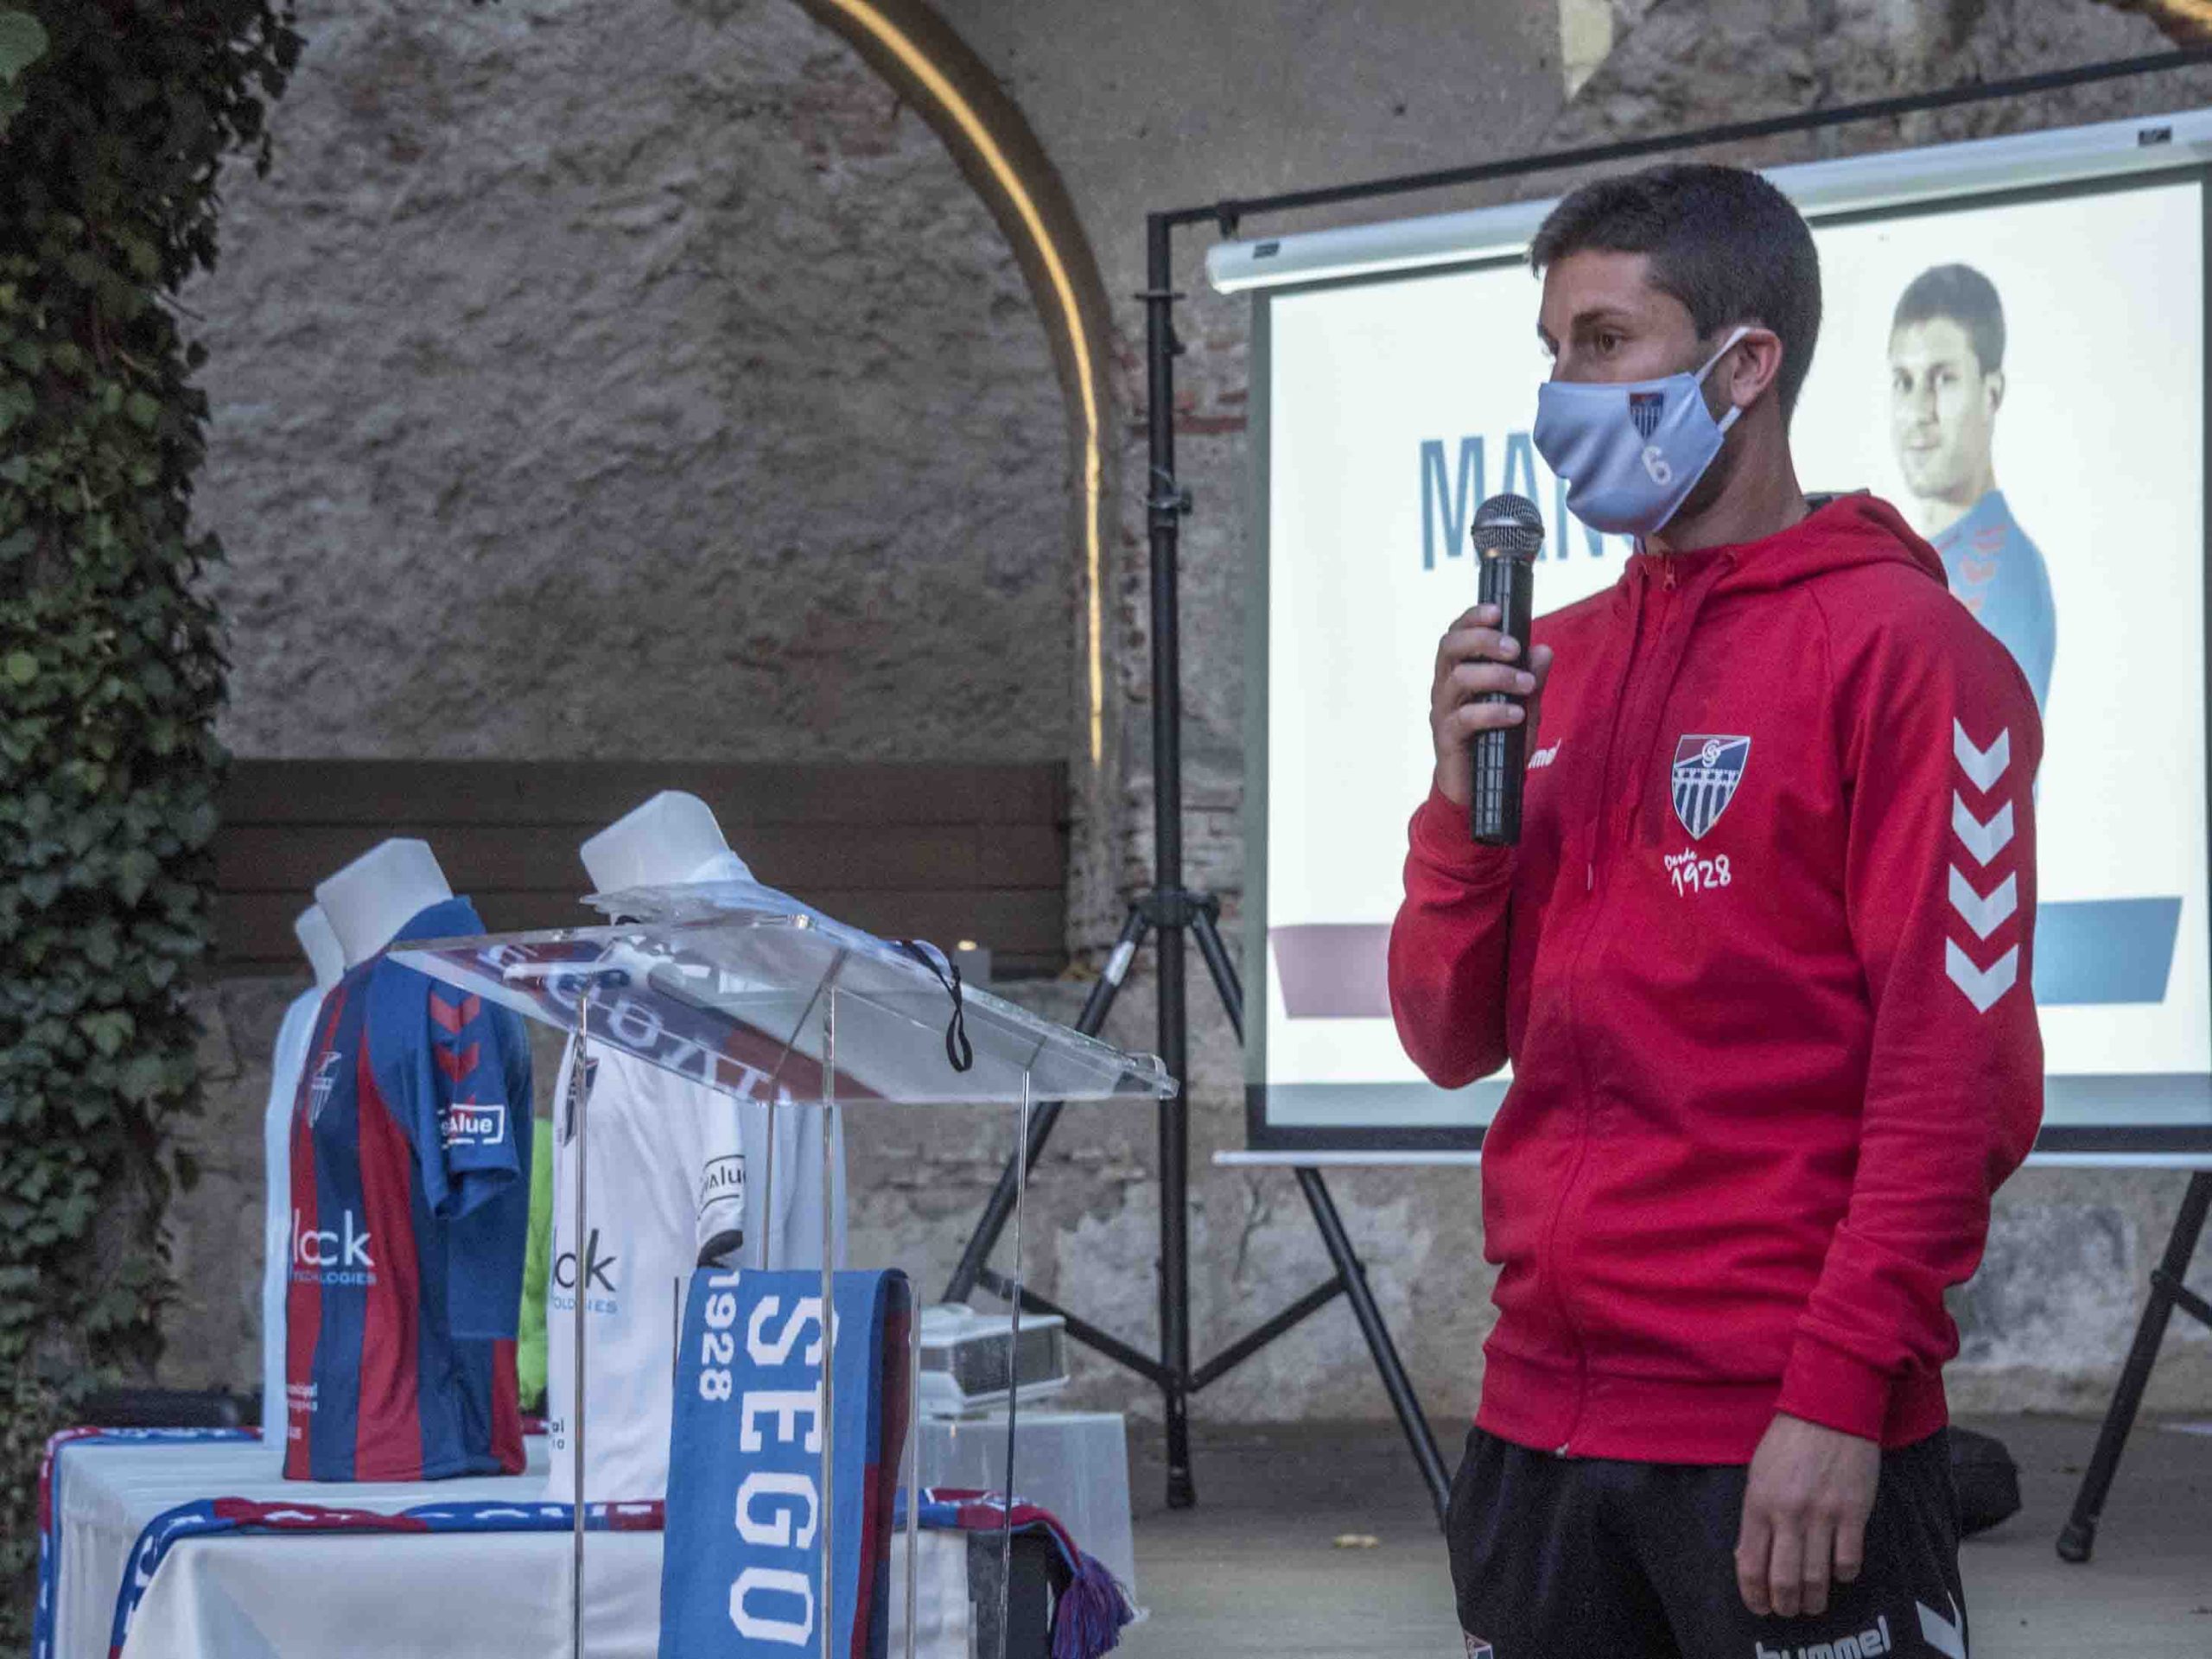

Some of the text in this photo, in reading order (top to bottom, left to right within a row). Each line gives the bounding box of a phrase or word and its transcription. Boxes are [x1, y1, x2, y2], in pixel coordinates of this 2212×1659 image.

[1642, 445, 1673, 486] 6
[1671, 854, 1732, 898] 1928
[698, 1271, 741, 1402] 1928
[729, 1296, 840, 1647] SEGO
